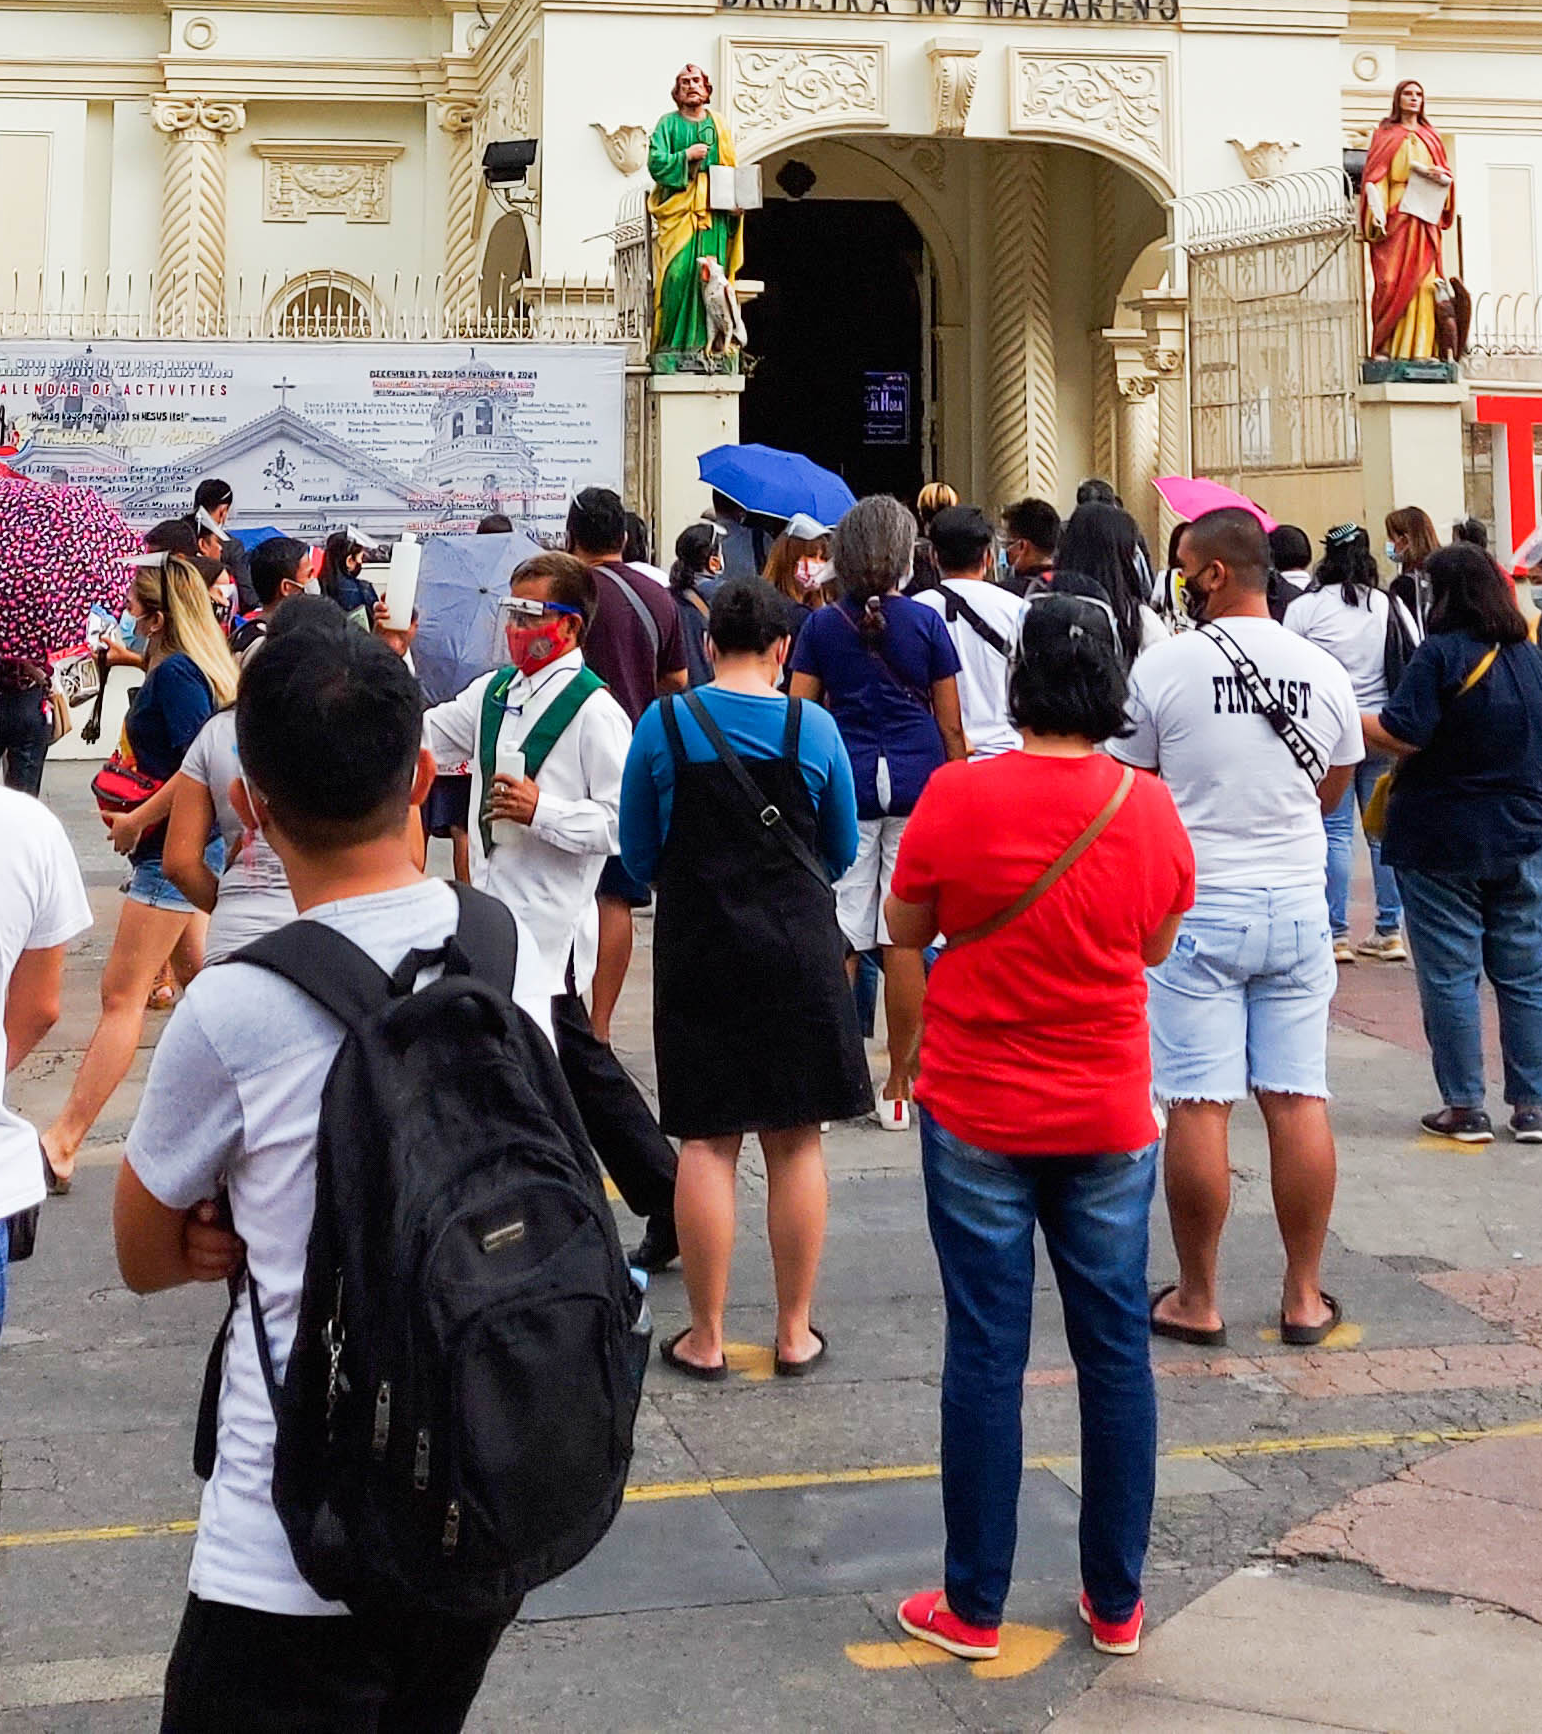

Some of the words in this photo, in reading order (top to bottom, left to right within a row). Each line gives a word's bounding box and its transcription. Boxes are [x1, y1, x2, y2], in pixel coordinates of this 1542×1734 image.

[92, 383, 112, 396] OF
[123, 383, 228, 397] ACTIVITIES
[141, 412, 168, 421] HESUS
